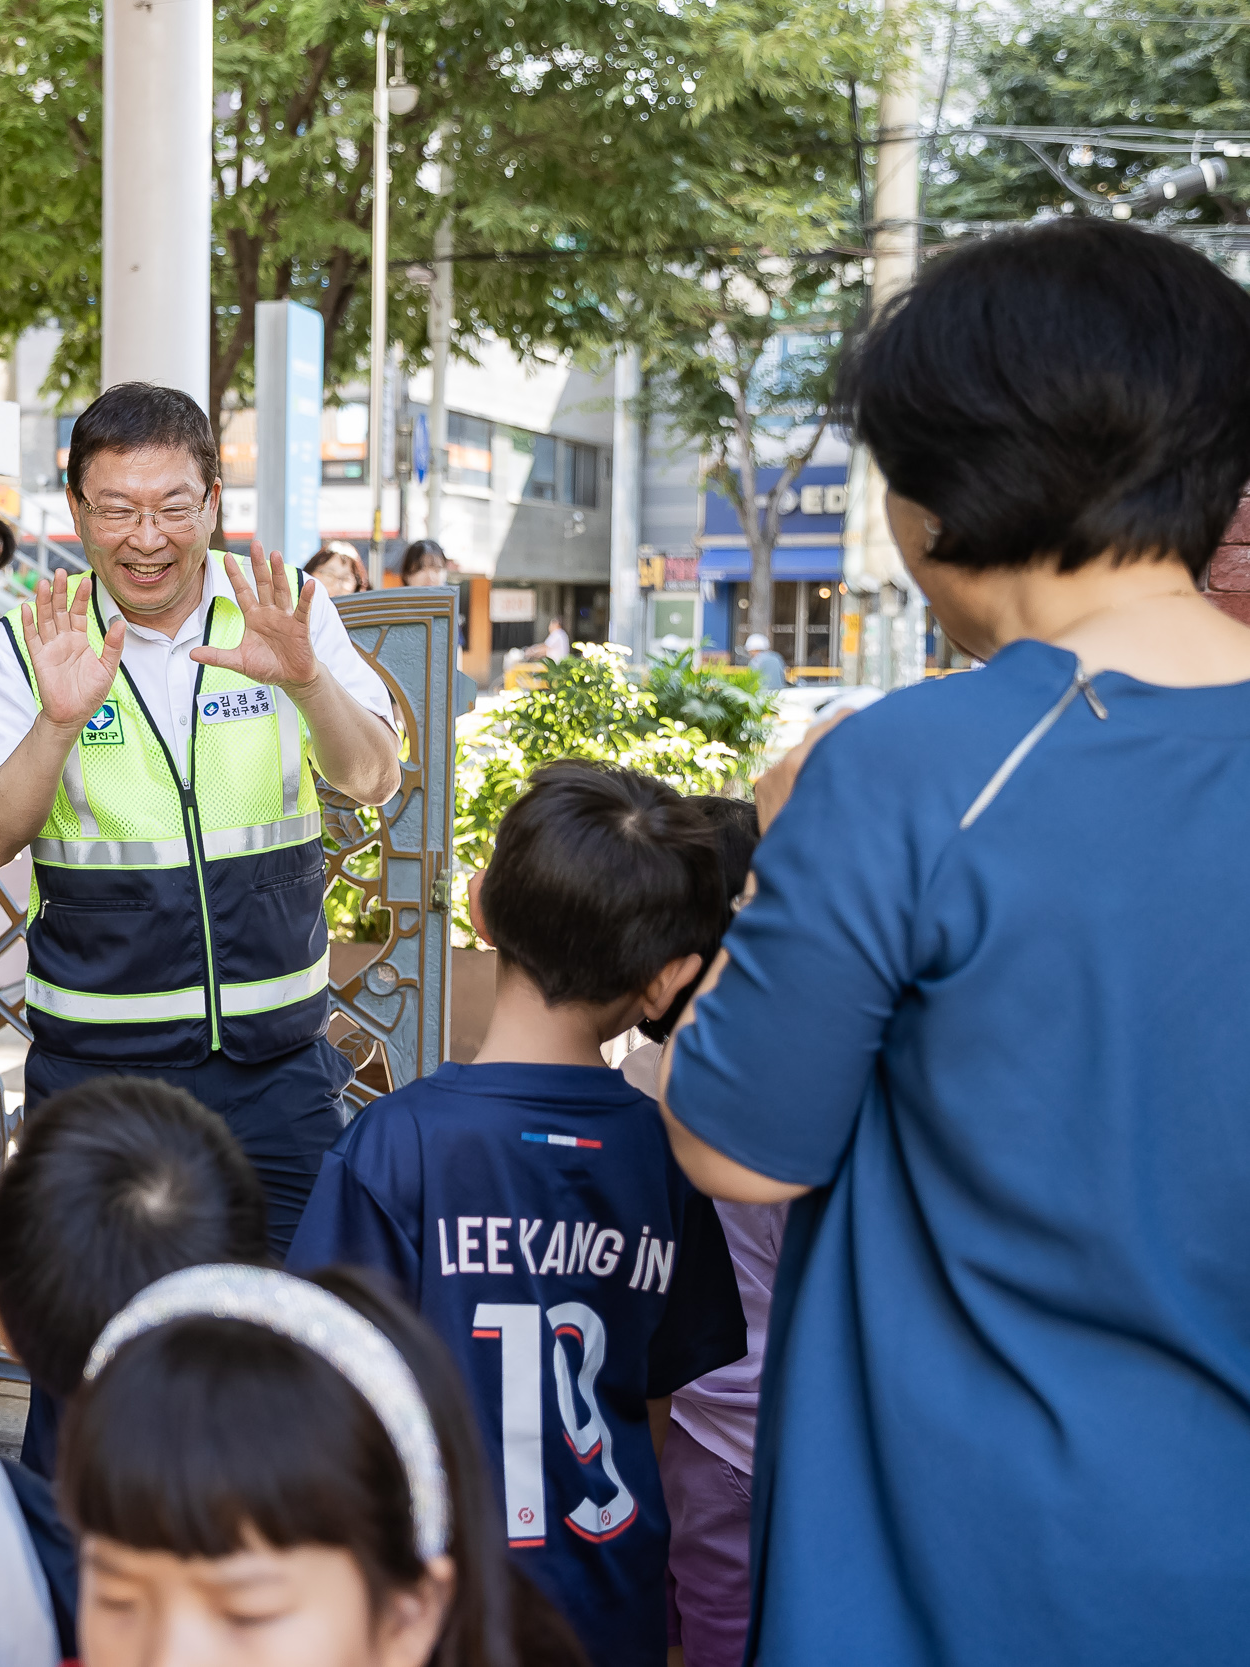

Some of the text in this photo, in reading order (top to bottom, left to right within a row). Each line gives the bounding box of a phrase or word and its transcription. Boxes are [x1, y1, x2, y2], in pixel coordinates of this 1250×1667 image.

[222, 702, 270, 718] 광진구청장
[85, 731, 119, 741] 광진구
[471, 1302, 639, 1549] 19
